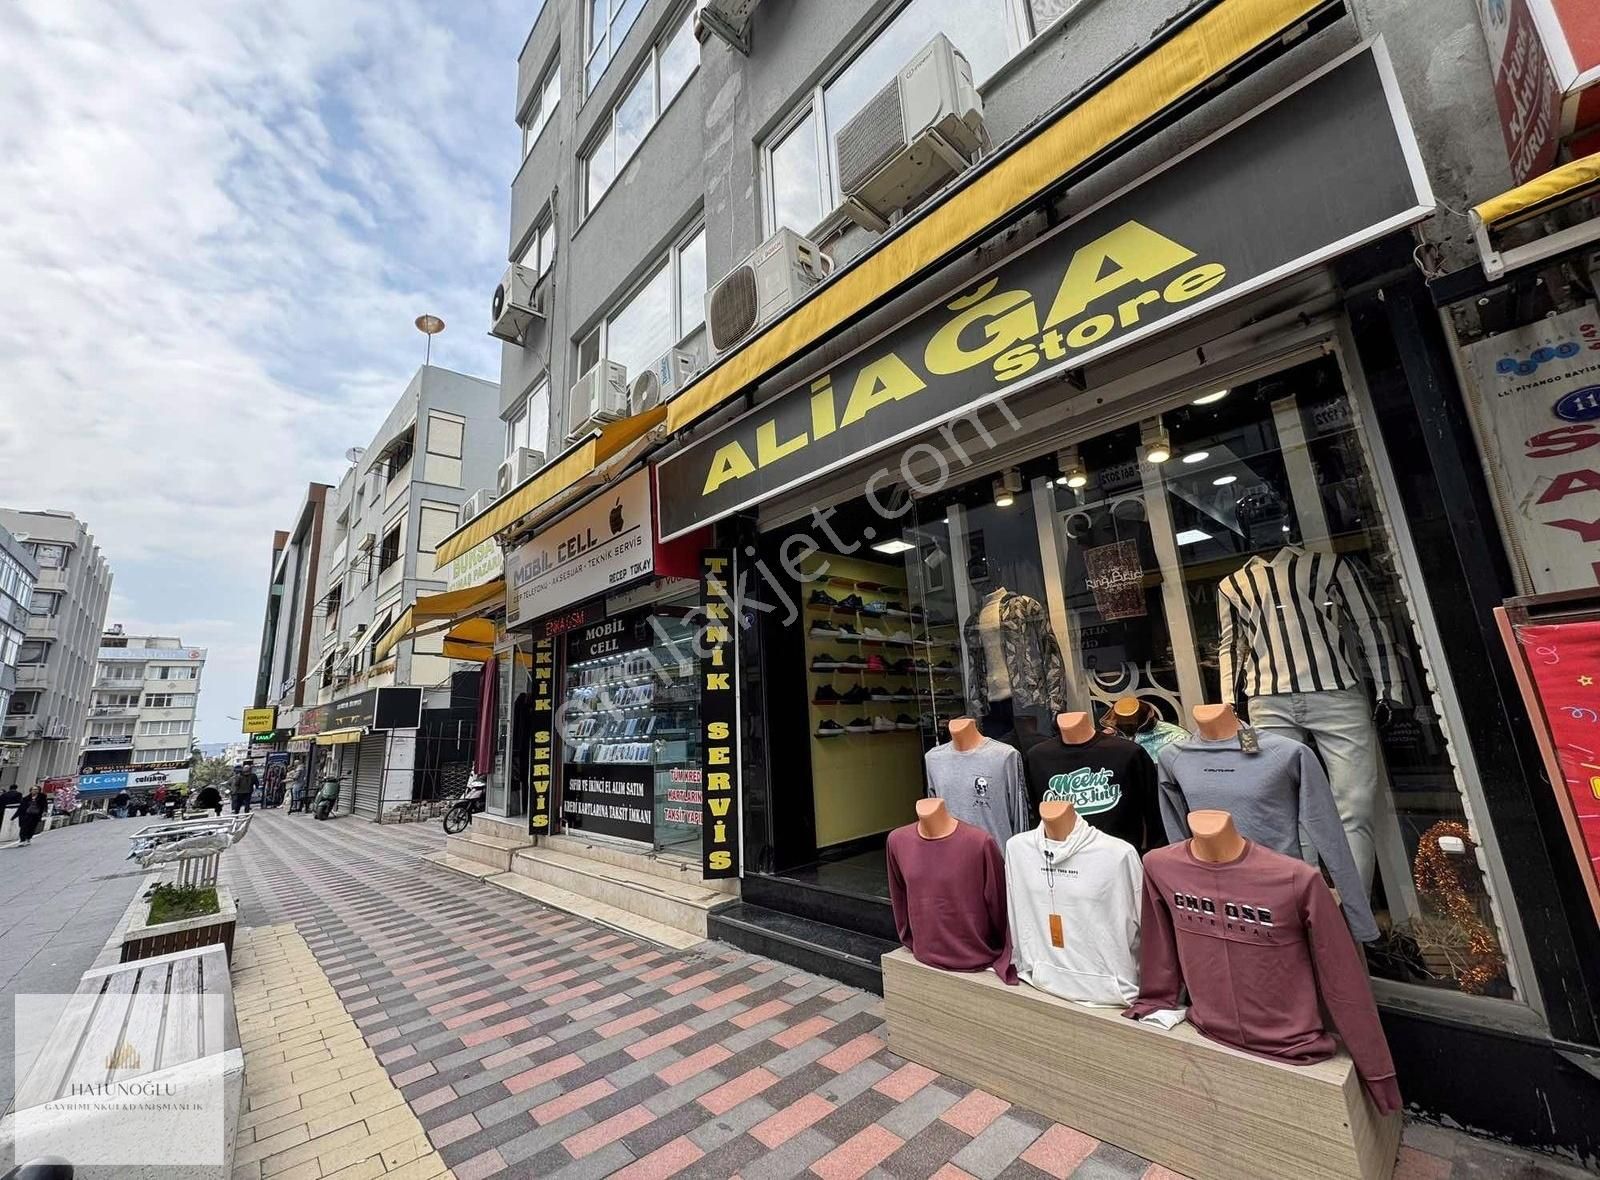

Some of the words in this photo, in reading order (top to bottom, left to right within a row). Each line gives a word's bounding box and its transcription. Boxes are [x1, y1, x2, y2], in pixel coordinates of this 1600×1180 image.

[702, 219, 1198, 496] ALİAĞA
[557, 527, 598, 563] CELL
[588, 549, 613, 568] TEKNİK
[614, 535, 642, 557] SERVİS
[608, 569, 627, 584] RECEP
[585, 619, 625, 640] MOBİL
[705, 557, 731, 690] TEKNİK
[590, 639, 619, 656] CELL
[532, 730, 550, 827] SERVİS
[626, 783, 645, 797] SATIM
[685, 769, 702, 784] KRED
[667, 789, 702, 804] KARTLARIN
[707, 721, 732, 870] SERVİS
